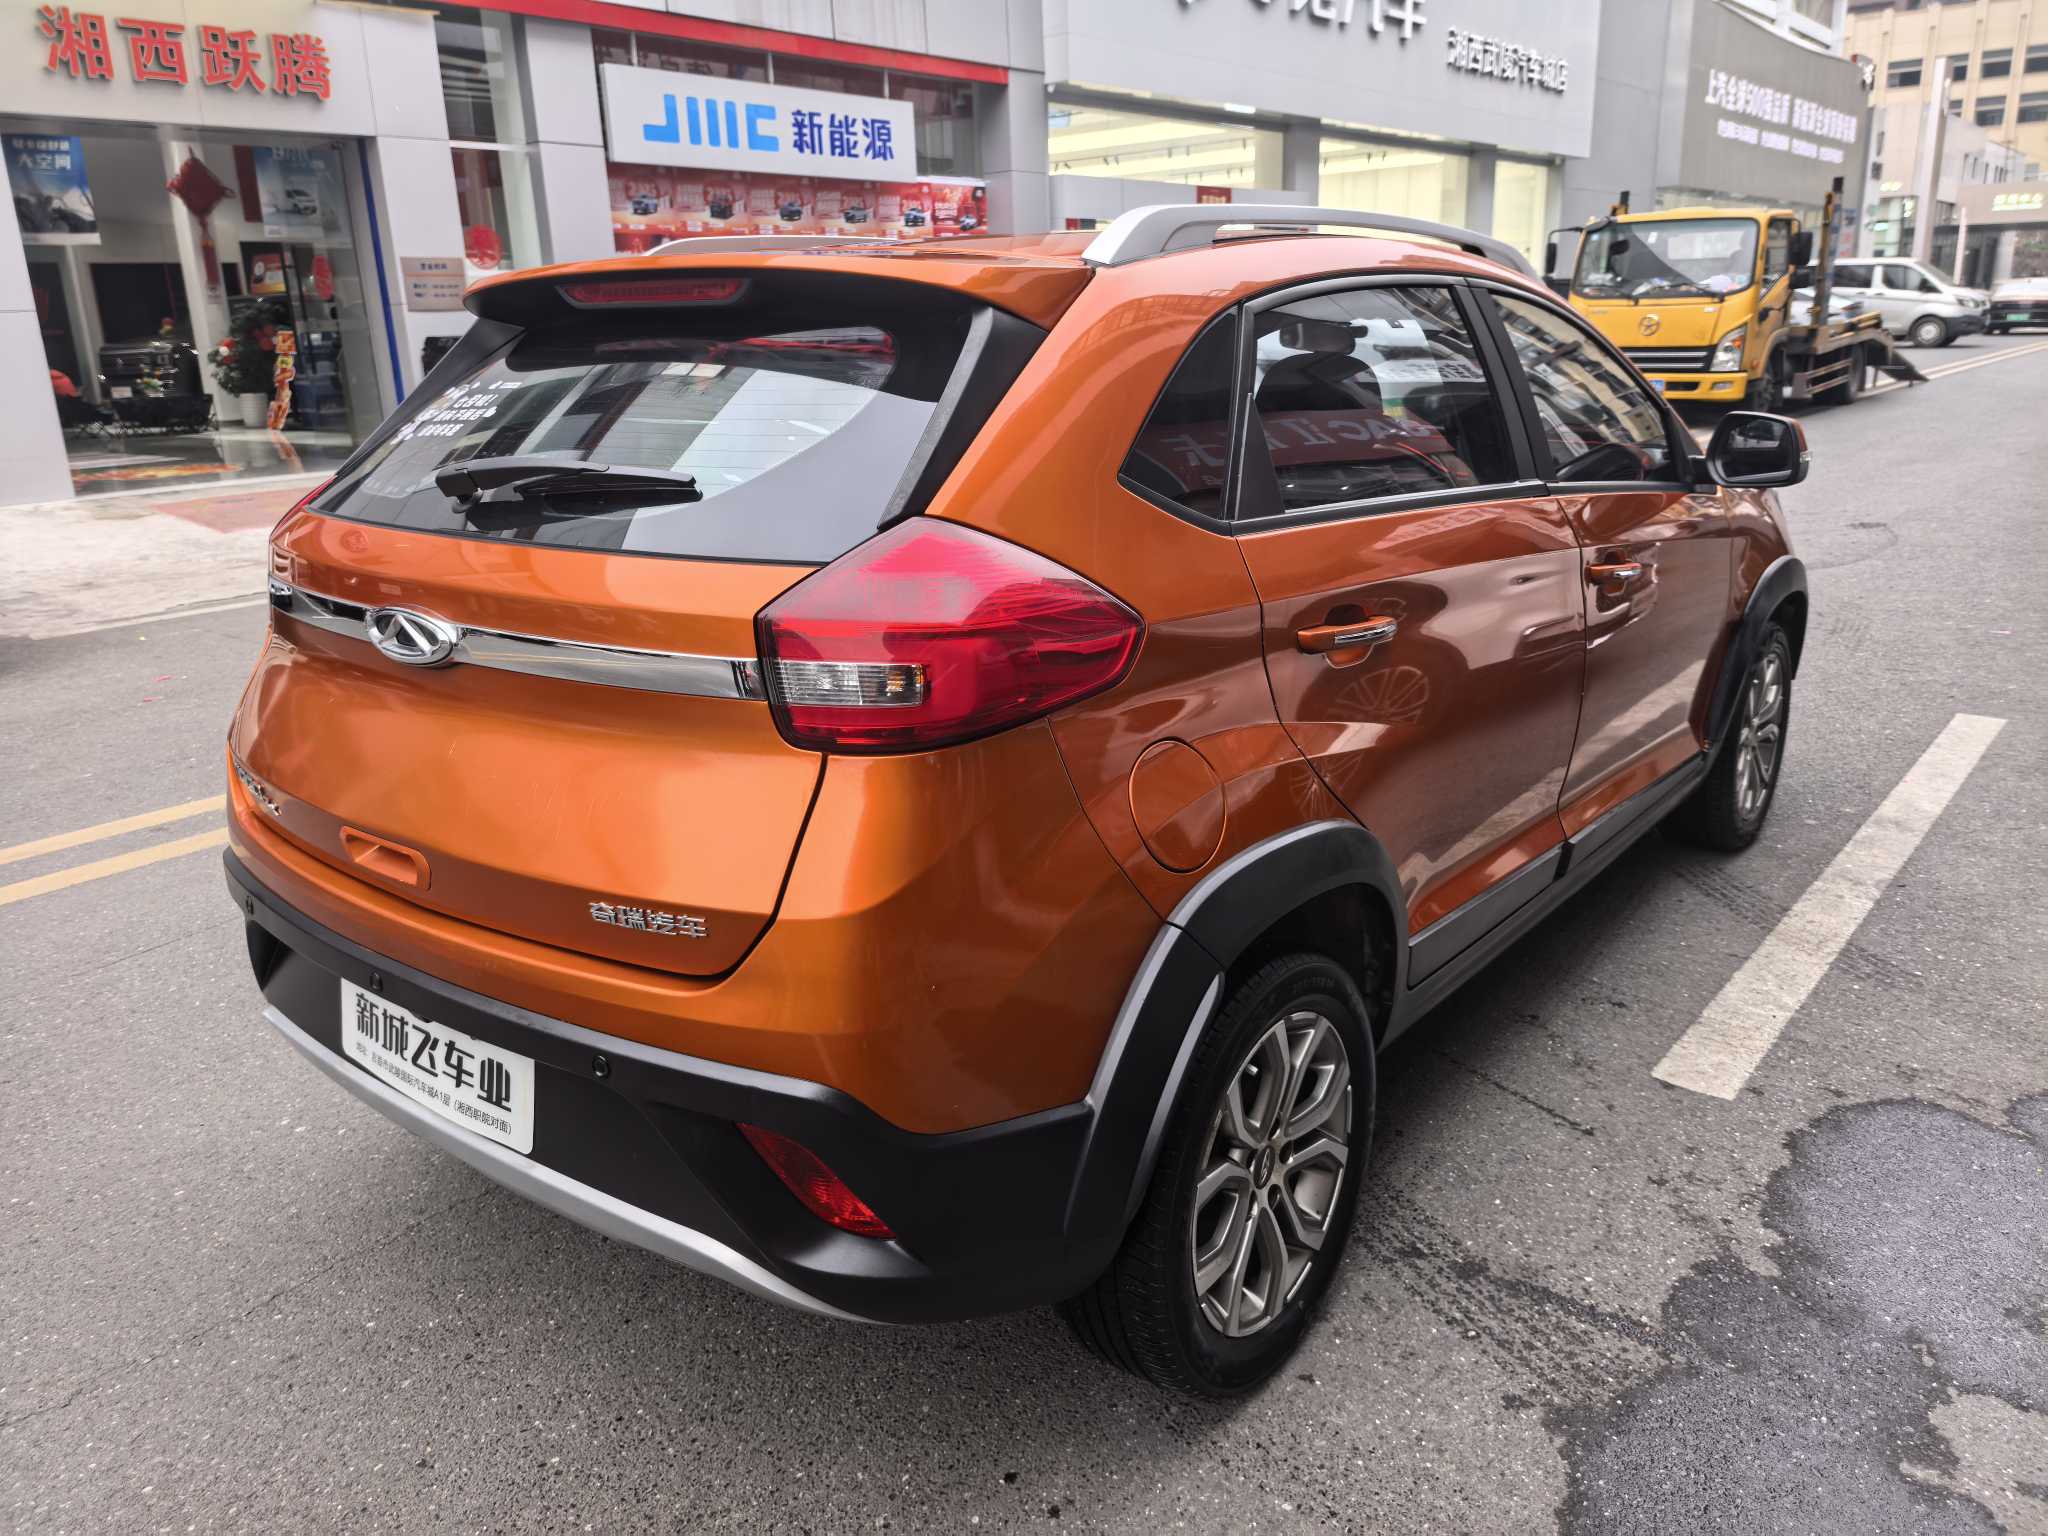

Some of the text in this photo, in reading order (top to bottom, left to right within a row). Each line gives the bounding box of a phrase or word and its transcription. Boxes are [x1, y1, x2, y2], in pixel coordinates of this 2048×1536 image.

[36, 5, 332, 101] 湘西跃腾
[643, 93, 895, 162] JMC 新能源
[588, 903, 707, 938] 奇瑞汽车
[355, 992, 512, 1113] 新城飞车业
